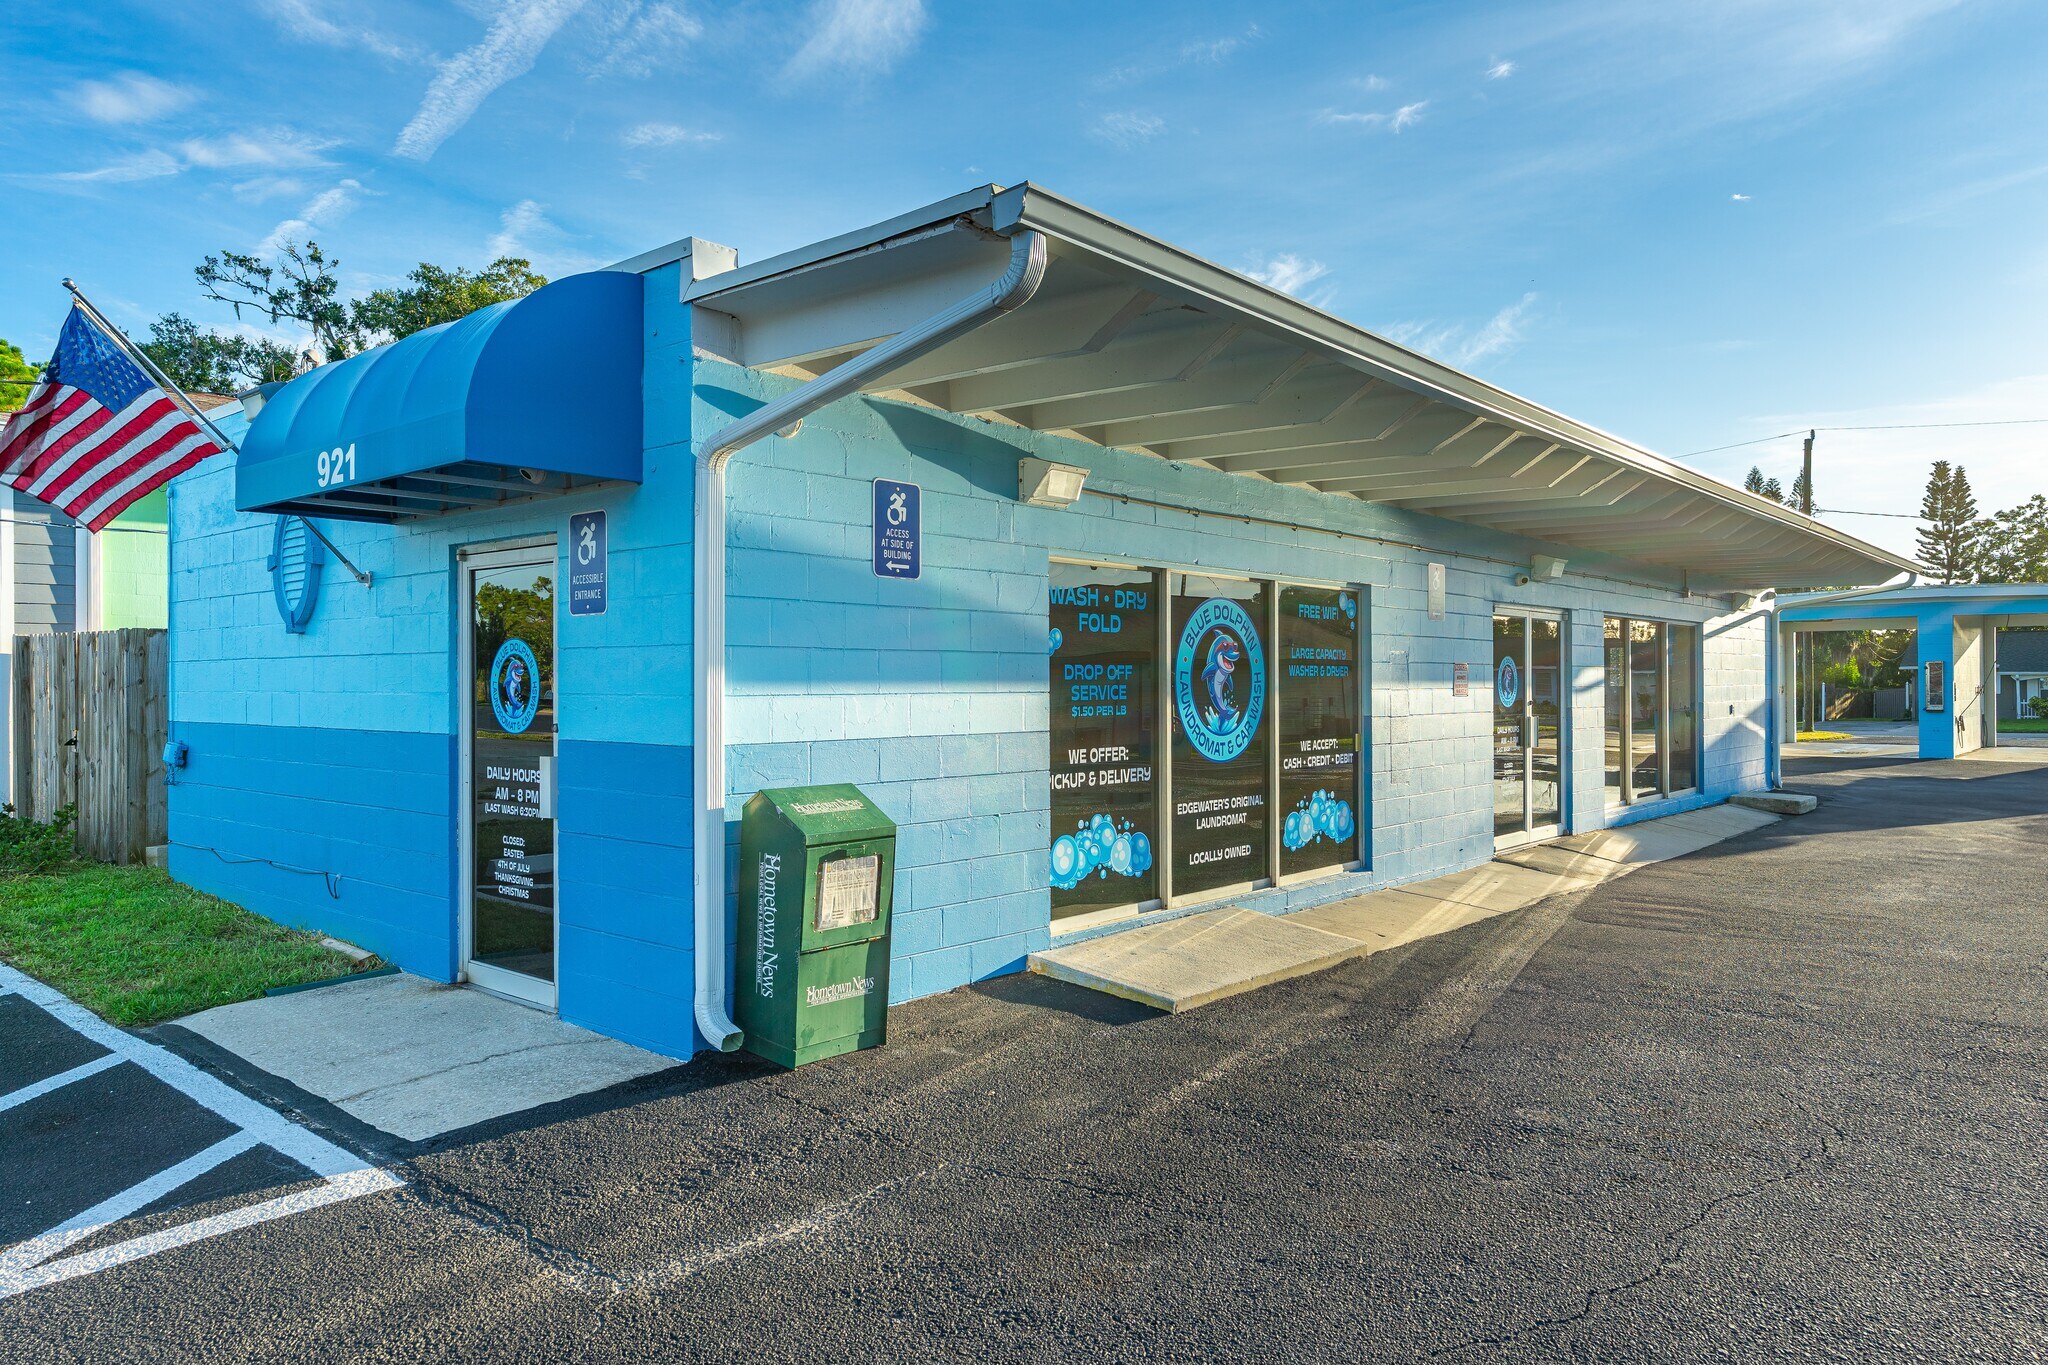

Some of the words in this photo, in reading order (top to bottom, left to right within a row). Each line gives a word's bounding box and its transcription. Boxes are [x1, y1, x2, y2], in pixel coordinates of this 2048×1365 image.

[317, 443, 356, 487] 921
[886, 528, 909, 538] ACCESS
[890, 540, 904, 549] SIDE
[906, 541, 914, 549] OF
[884, 550, 911, 560] BUILDING
[572, 573, 604, 585] ACCESSIBLE
[575, 589, 601, 600] ENTRANCE
[1050, 586, 1099, 607] WASH
[1114, 590, 1146, 610] DRY
[1298, 604, 1320, 618] FREE
[1322, 606, 1339, 620] WIFI
[1078, 613, 1121, 633] FOLD
[1185, 608, 1211, 649] BLUE
[1213, 604, 1258, 652] DOLPHIN
[496, 646, 510, 669] BLUE
[510, 643, 534, 669] DOLPHIN
[1291, 647, 1314, 660] LARGE
[1316, 649, 1347, 661] CAPACITY
[1064, 664, 1103, 680] DROP
[1107, 664, 1132, 680] OFF
[1288, 665, 1318, 677] WASHER
[1320, 666, 1324, 677] &
[1326, 665, 1349, 677] DRYER
[1071, 685, 1126, 700] SERVICE
[1072, 706, 1094, 718] $1.50
[1096, 706, 1114, 716] PER
[1116, 706, 1126, 716] LB
[1180, 670, 1225, 756] LAUNDROMAT
[1227, 740, 1234, 754] &
[1235, 720, 1254, 749] CAR
[1249, 672, 1262, 720] WASH
[1300, 740, 1312, 751] WE
[1313, 738, 1338, 750] ACCEPT:
[1068, 749, 1086, 764] WE
[1090, 746, 1129, 763] OFFER:
[1283, 758, 1302, 770] CASH
[1308, 754, 1330, 767] CREDIT
[1335, 753, 1353, 764] DEBIT
[486, 766, 510, 780] DAILY
[512, 768, 540, 784] HOURS
[1050, 772, 1086, 790] ICKUP
[1089, 772, 1096, 787] &
[1100, 767, 1151, 785] DELIVERY
[495, 787, 508, 800] AM
[518, 790, 523, 802] 8
[526, 791, 539, 804] PM
[485, 802, 500, 814] (LAST
[502, 804, 518, 816] WASH
[1177, 798, 1230, 815] EDGEWATER'S
[1231, 795, 1263, 808] ORIGINAL
[1196, 813, 1247, 830] LAUNDROMAT
[503, 835, 525, 846] CLOSED:
[504, 848, 524, 859] EASTER
[1189, 848, 1222, 865] LOCALLY
[1224, 844, 1251, 860] OWNED
[498, 860, 508, 869] 4TH
[509, 862, 516, 870] OF
[517, 863, 530, 873] JULY
[494, 872, 534, 887] THANKSGIVING
[498, 885, 529, 899] CHRISTMAS
[763, 853, 780, 949] Hometown
[762, 951, 778, 998] News
[806, 982, 852, 1002] Hometown
[852, 976, 874, 991] News
